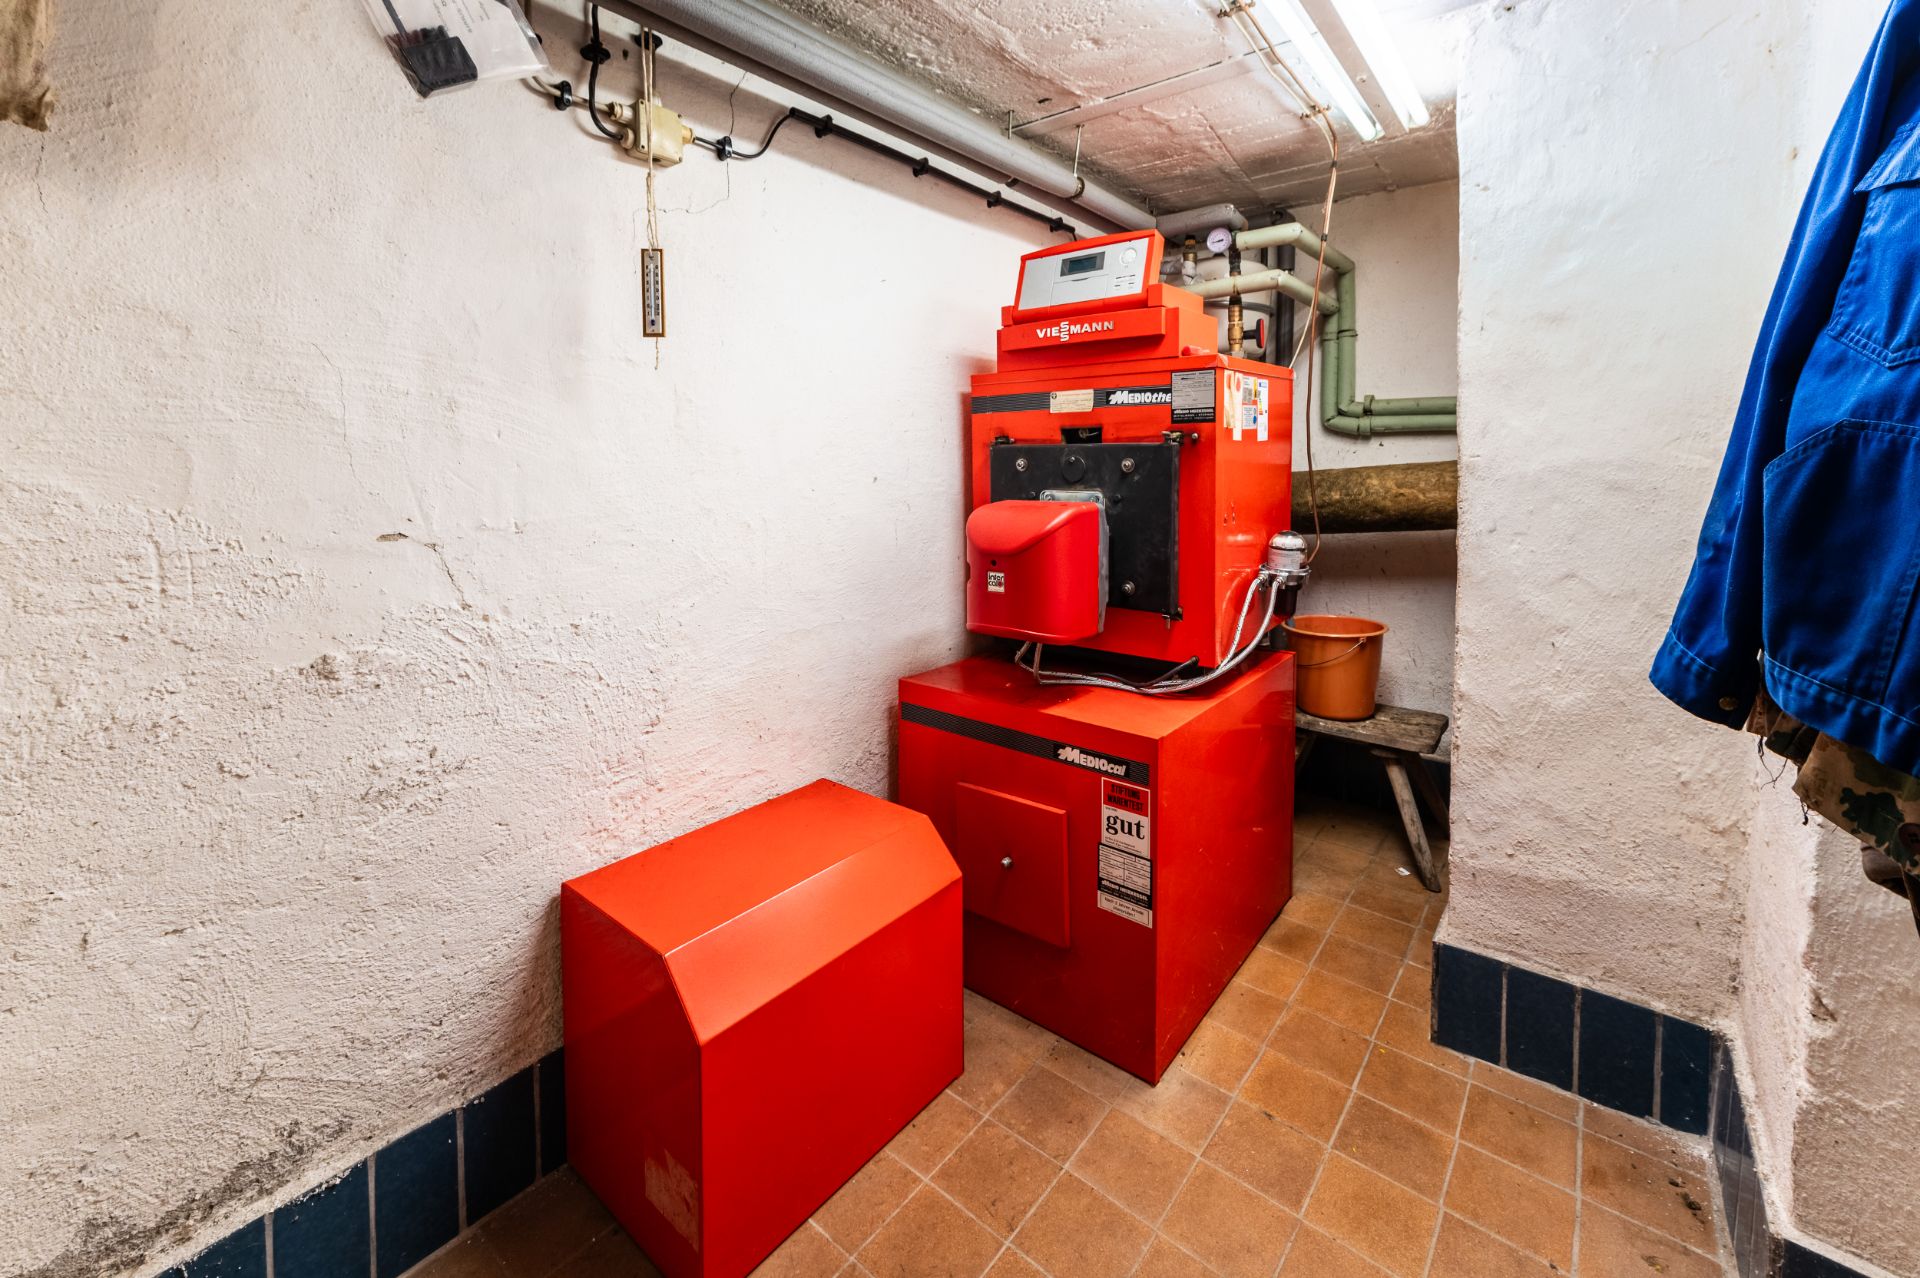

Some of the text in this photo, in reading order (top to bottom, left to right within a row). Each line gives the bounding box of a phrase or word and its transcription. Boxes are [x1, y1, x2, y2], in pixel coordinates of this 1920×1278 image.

[1036, 321, 1114, 342] VIESSMANN
[1057, 746, 1126, 776] MEDIOcal
[1111, 783, 1140, 800] STIFTUNG
[1107, 794, 1144, 812] WARENTEST
[1105, 815, 1145, 840] gut
